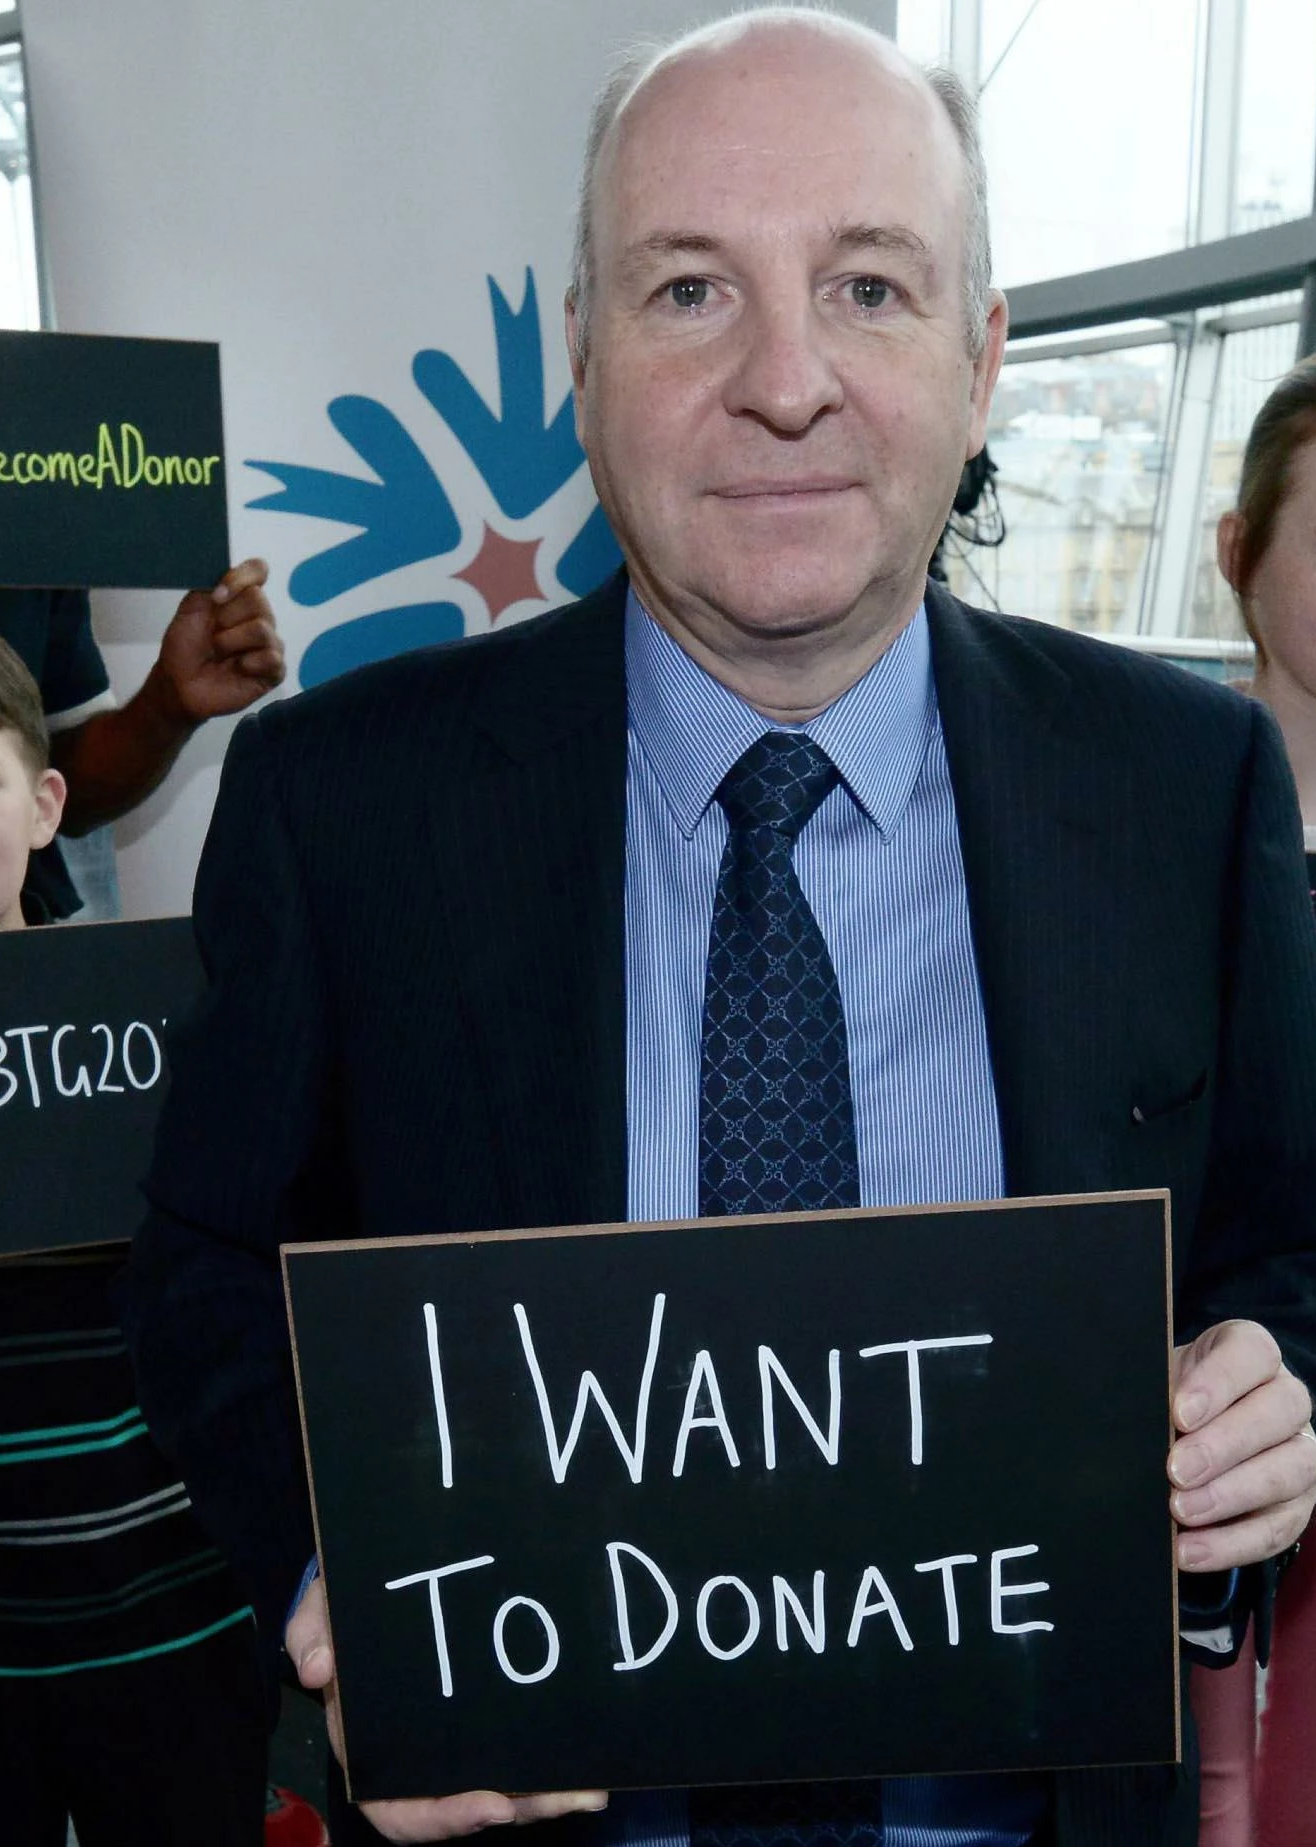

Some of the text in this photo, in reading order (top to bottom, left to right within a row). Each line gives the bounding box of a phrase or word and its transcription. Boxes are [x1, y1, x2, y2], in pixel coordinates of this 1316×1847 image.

[422, 1292, 994, 1490] I WANT
[605, 1541, 1056, 1673] DONATE
